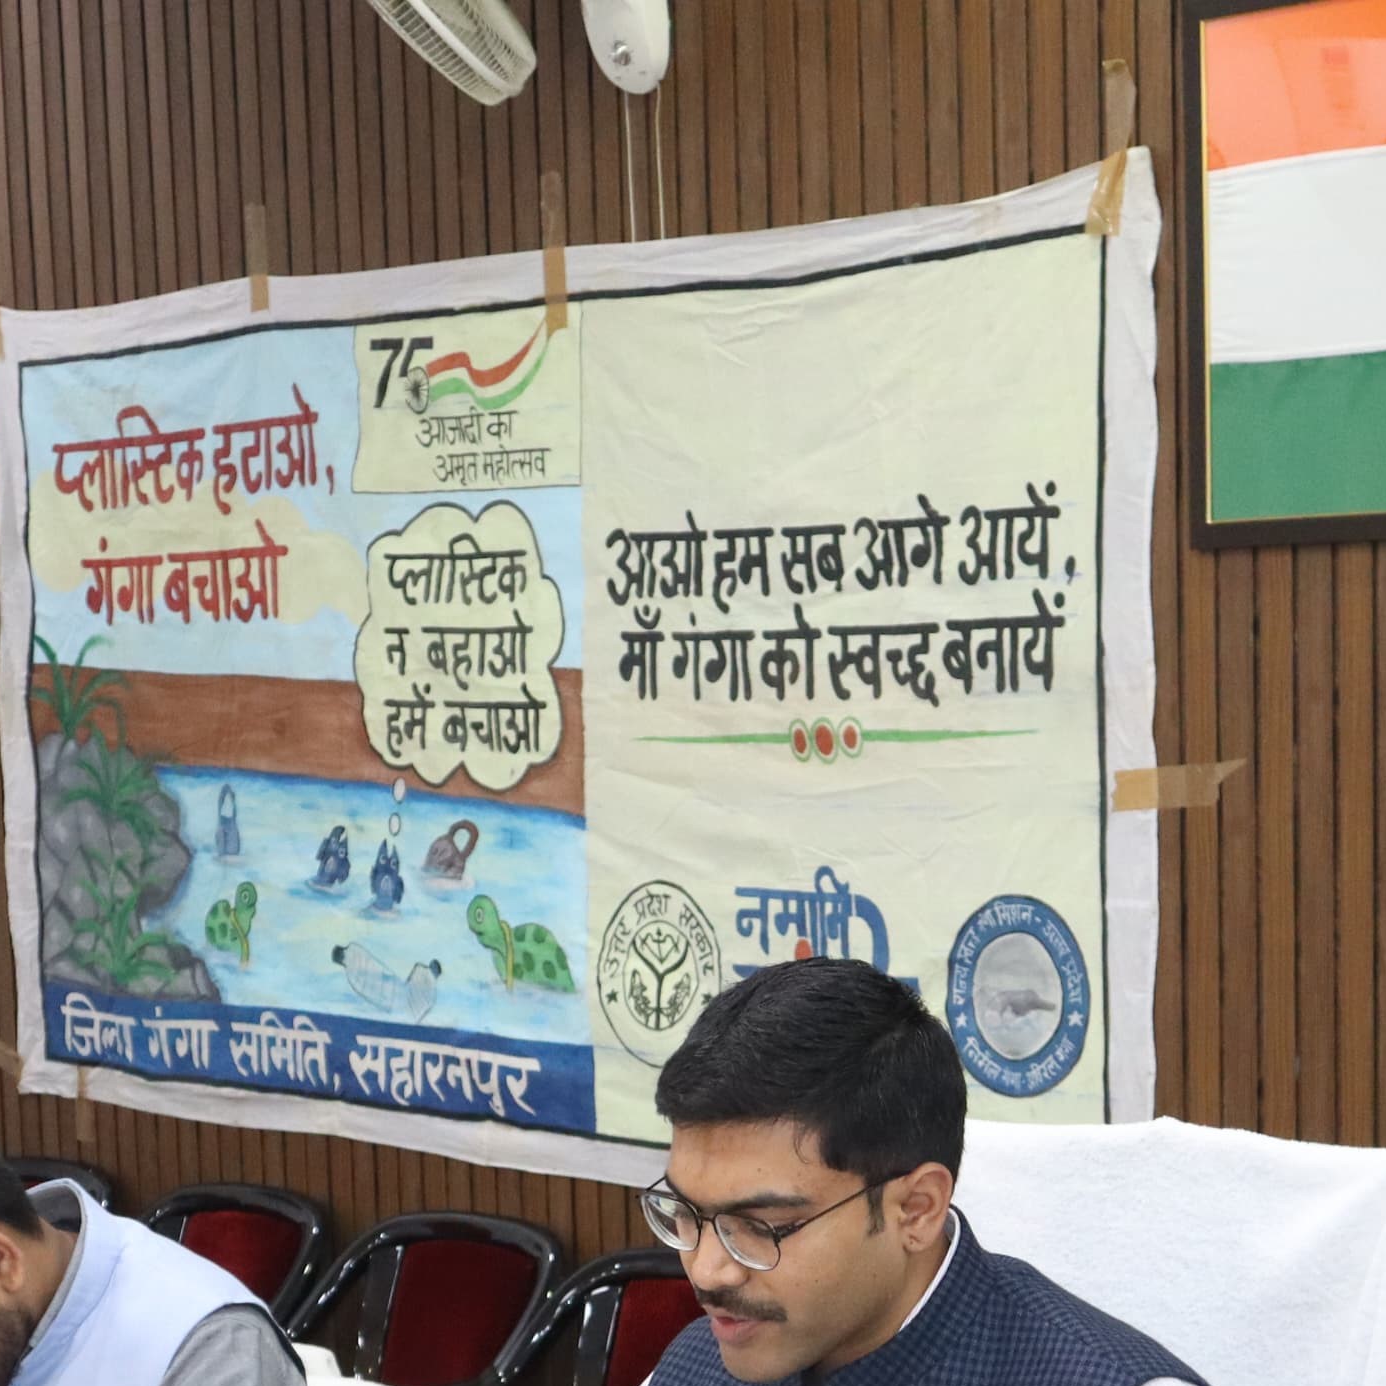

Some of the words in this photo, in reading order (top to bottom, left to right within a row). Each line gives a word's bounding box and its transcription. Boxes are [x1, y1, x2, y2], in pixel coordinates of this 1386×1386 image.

[53, 405, 205, 512] प्लास्टिक
[212, 383, 334, 516] हटाओ,
[416, 406, 483, 448] आजादी
[486, 410, 519, 440] का
[433, 453, 479, 486] अमृत
[483, 445, 551, 482] महोत्सव
[82, 537, 162, 625] गंगा
[163, 519, 288, 624] बचाओ
[384, 533, 526, 605] प्लास्टिक
[606, 510, 706, 606] आओ
[713, 527, 773, 614] हम
[781, 524, 844, 594] सब
[853, 493, 949, 591] आगे
[385, 627, 409, 675] न
[422, 610, 533, 690] बहाओ
[619, 605, 664, 700] माँ
[671, 612, 754, 702] गंगा
[760, 603, 821, 700] को
[943, 589, 1065, 694] बनायें
[384, 683, 435, 758] हमें
[443, 682, 546, 754] बचाओ
[604, 915, 631, 979] उत्तर
[633, 888, 672, 923] प्रदेश
[678, 903, 714, 977] सरकार
[735, 865, 852, 960] नमामि
[61, 986, 135, 1061] जिला
[142, 1008, 218, 1069] गंगा
[229, 1010, 340, 1094] समिति,
[348, 1033, 540, 1116] सहारनपुर
